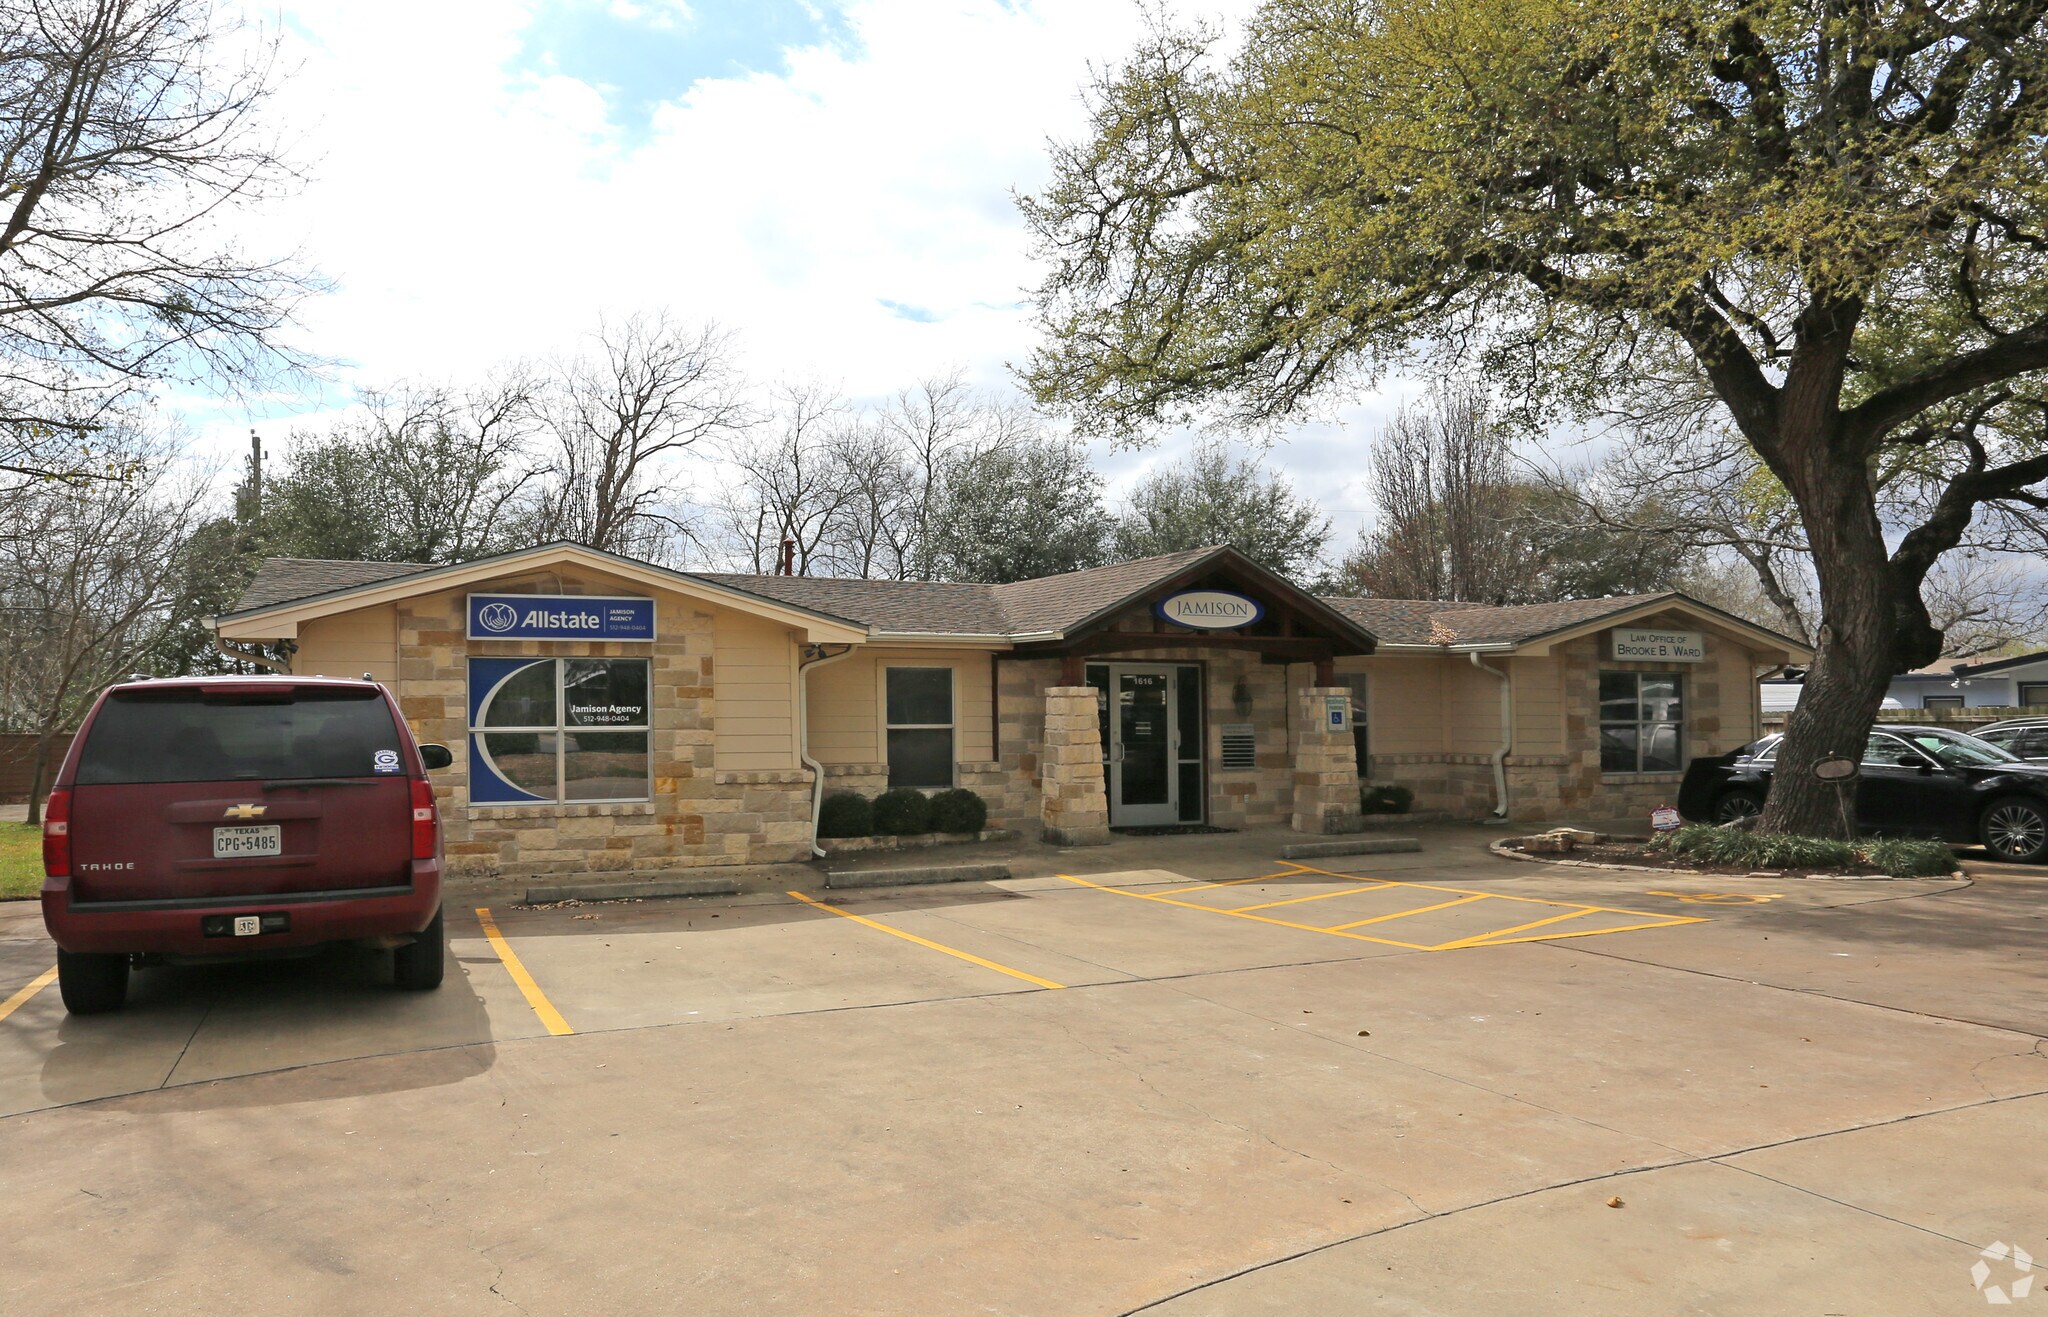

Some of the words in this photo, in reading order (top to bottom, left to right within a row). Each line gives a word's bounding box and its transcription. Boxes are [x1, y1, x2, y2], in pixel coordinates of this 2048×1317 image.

[1177, 601, 1248, 616] JAMISON
[520, 610, 600, 629] Allstate
[1630, 633, 1646, 642] LAW
[1649, 634, 1675, 643] OFFICE
[1617, 644, 1656, 656] BROOKE
[1659, 645, 1669, 656] B.
[1673, 646, 1701, 657] WARD
[1134, 677, 1153, 685] 1616
[571, 704, 607, 713] Jamison
[608, 704, 642, 715] Agency
[583, 715, 630, 723] 512-948-0404
[234, 827, 260, 835] TEXAS
[80, 862, 135, 871] TAHOE
